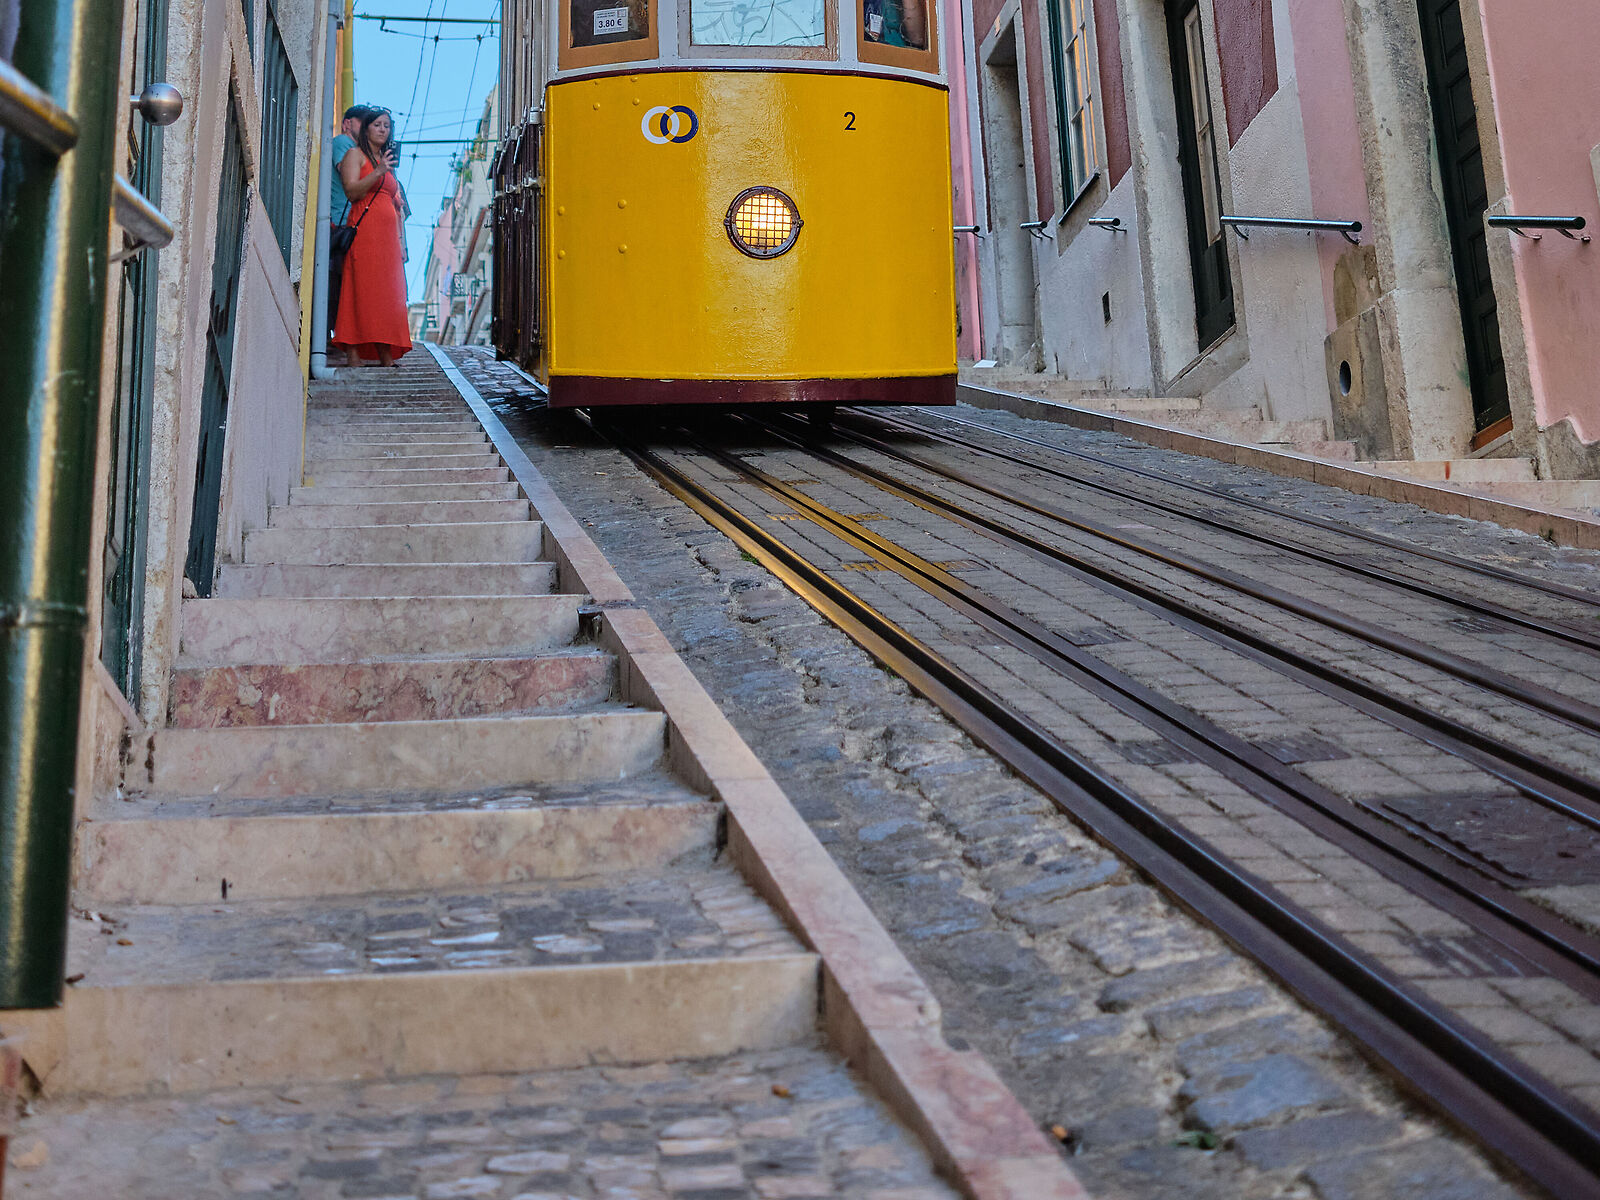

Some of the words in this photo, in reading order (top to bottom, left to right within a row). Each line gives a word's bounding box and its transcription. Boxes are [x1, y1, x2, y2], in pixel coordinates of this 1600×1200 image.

[598, 19, 615, 28] 3.80
[617, 18, 623, 26] €
[843, 111, 857, 131] 2
